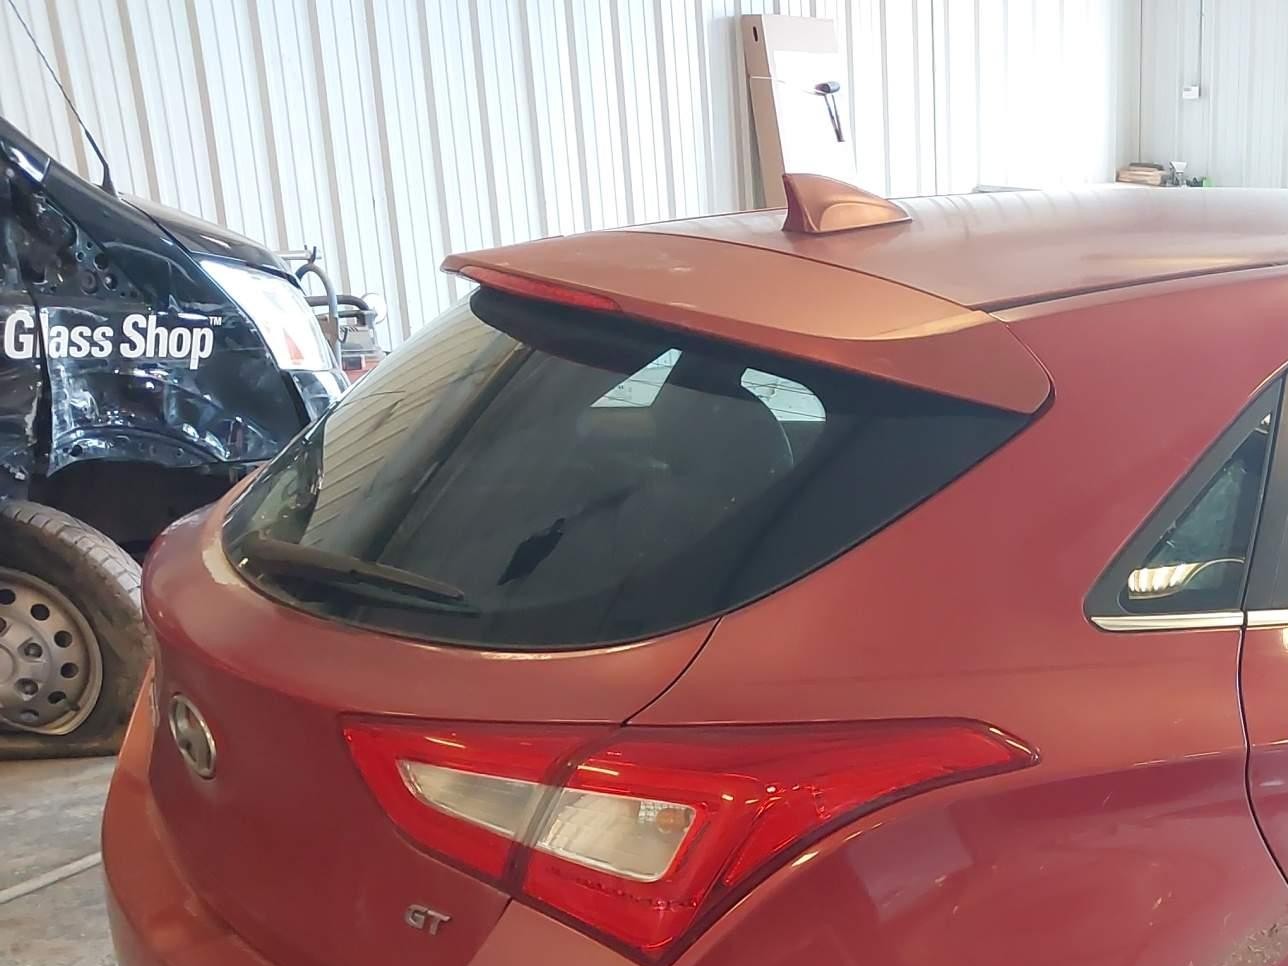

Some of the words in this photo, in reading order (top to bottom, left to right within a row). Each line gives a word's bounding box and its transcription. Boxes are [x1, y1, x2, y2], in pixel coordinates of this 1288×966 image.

[4, 309, 114, 360] Glass
[120, 312, 214, 370] Shop
[404, 904, 451, 936] GT
